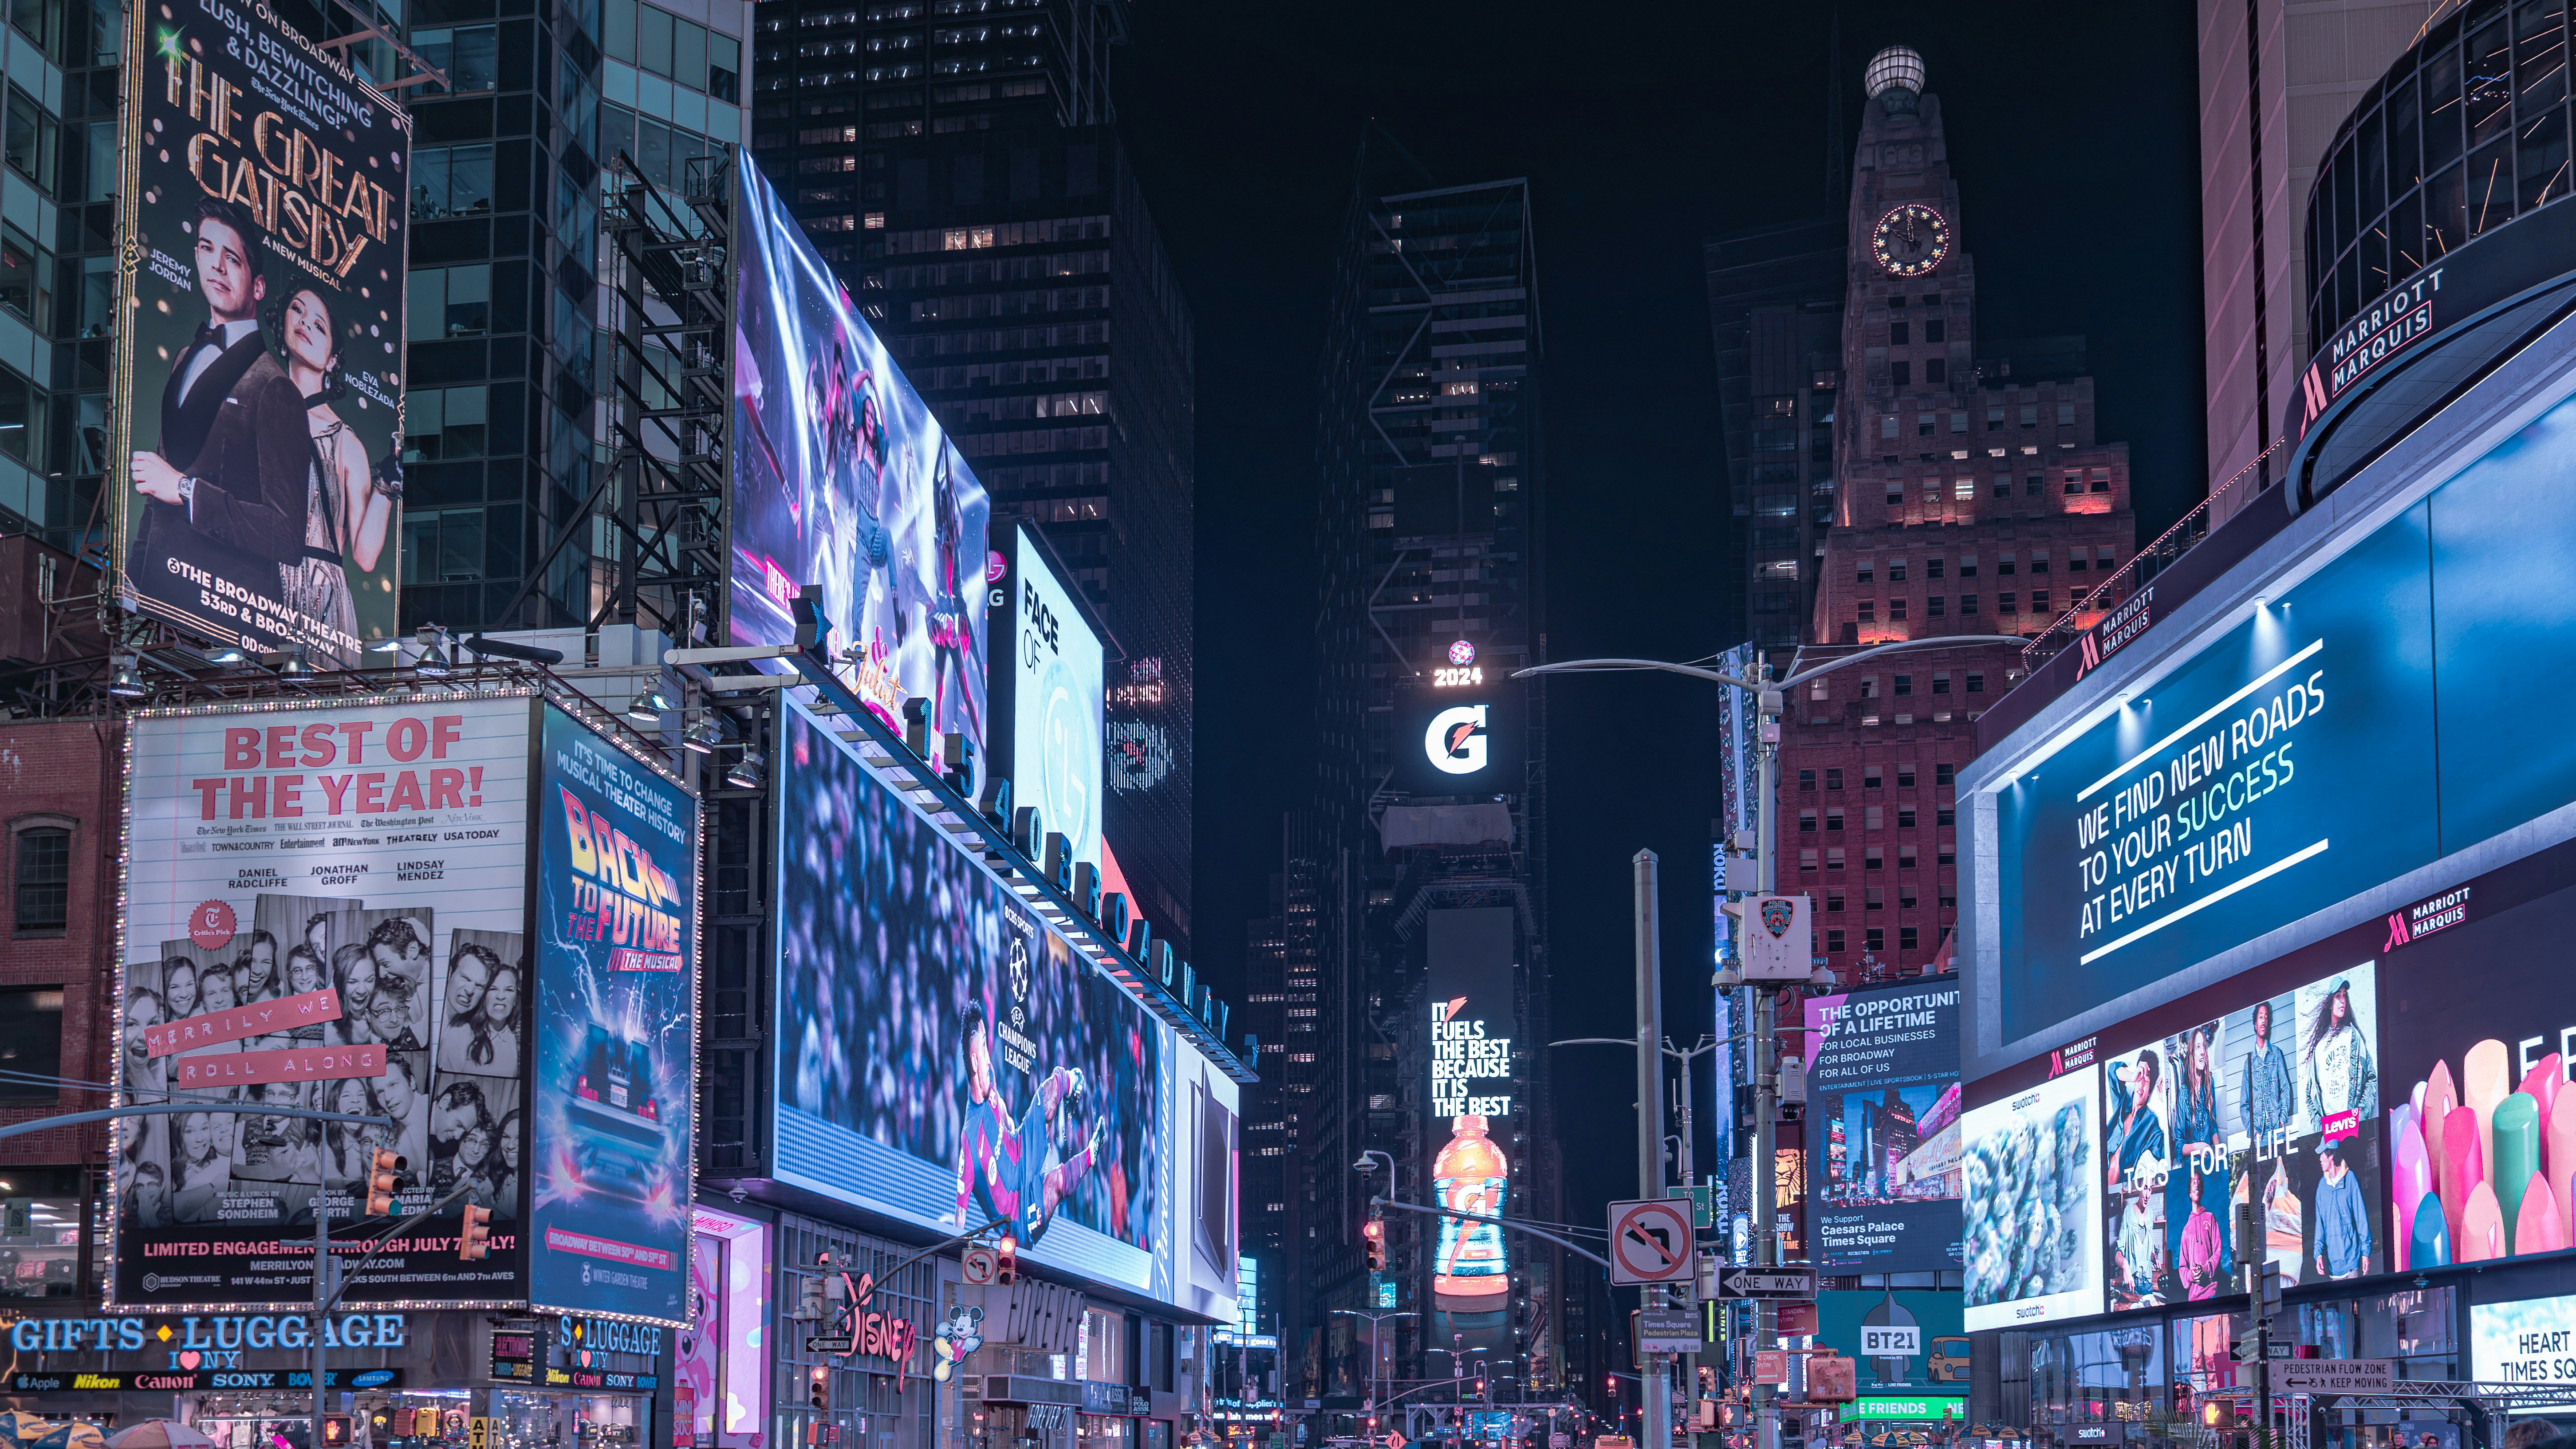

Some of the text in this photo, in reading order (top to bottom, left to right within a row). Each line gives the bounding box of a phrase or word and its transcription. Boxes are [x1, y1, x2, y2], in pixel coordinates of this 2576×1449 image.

[282, 20, 355, 84] BROADWAY
[259, 32, 371, 128] BEWITCHING
[254, 111, 395, 244] GREAT
[188, 134, 368, 277] GATSBY
[150, 248, 191, 278] JEREMY
[149, 261, 191, 292] JORDAN
[297, 256, 342, 291] MUSICAL
[2333, 268, 2444, 363] MARRIOTT
[2335, 309, 2428, 392] MARQUIS
[180, 562, 362, 654] THE BROADWAY THEATRE
[240, 608, 252, 624] &
[1025, 577, 1058, 656] FACE
[2103, 586, 2155, 636] MARRIOTT
[2103, 611, 2149, 655] MARQUIS
[1024, 629, 1041, 674] OF
[1434, 667, 1482, 686] 2024
[224, 715, 462, 771] BEST OF
[2078, 670, 2325, 849] WE FIND NEW ROADS
[193, 766, 484, 821] THE YEAR!
[595, 753, 673, 818] TIME CHANGE
[557, 750, 685, 844] MUSICAL THEATER HISTORY
[2079, 741, 2294, 891] TO YOUR SUCCESS
[212, 842, 275, 852] TOWN&COUNTRY
[387, 834, 438, 845] THEATRELY
[239, 869, 277, 878] DANIEL
[311, 864, 369, 875] JONATHAN
[397, 860, 445, 871] LINDSAY
[397, 870, 444, 881] MENDEZ
[228, 878, 288, 889] RADCLIFFE
[321, 875, 358, 885] GROFF
[2081, 817, 2252, 939] AT EVERY TURN
[2413, 887, 2470, 919] MARRIOTT
[595, 886, 681, 952] FUTURE
[2414, 907, 2464, 936] MARQUIS
[1819, 1004, 1851, 1021] THE
[147, 1009, 273, 1049] MERRILY
[1432, 1020, 1485, 1040] FUELS
[1820, 1010, 1935, 1037] OF A LIFETIME
[998, 1021, 1036, 1059] CHAMPIONS
[1432, 1039, 1510, 1059] THE BEST
[1819, 1029, 1935, 1051] FOR LOCAL BUSINESSES
[2064, 1037, 2097, 1056] MARRIOTT
[1004, 1047, 1030, 1075] LEAGUE
[1820, 1048, 1895, 1065] FOR BROADWAY
[2065, 1052, 2094, 1069] MARQUIS
[185, 1062, 255, 1081] ROLL
[1432, 1058, 1510, 1079] BECAUSE
[1820, 1063, 1890, 1079] FOR ALL OF US
[1432, 1078, 1468, 1098] IT IS
[1819, 1081, 1866, 1091] ENTERTAINMENT
[1884, 1075, 1922, 1084] SPORTSBOOK
[1432, 1096, 1511, 1117] THE BEST
[2190, 1124, 2299, 1177] FOR LIFE
[222, 1197, 274, 1208] STEPHEN
[217, 1209, 279, 1220] SONDHEIM
[693, 1216, 734, 1232] MINISO
[1834, 1214, 1863, 1225] Support
[1821, 1222, 1904, 1235] Caesars Palace
[144, 1242, 210, 1256] LIMITED
[1822, 1235, 1896, 1247] Times Square
[369, 1275, 398, 1283] SOUTH
[399, 1274, 441, 1282] BETWEEN
[1734, 1277, 1803, 1289] ONE WAY
[1782, 1308, 1805, 1317] STANDING
[1666, 1320, 1691, 1329] Square
[11, 1318, 145, 1352] GIFTS
[585, 1318, 661, 1355] LUGGAGE
[1867, 1332, 1914, 1349] BT21
[2520, 1331, 2570, 1354] HEART
[168, 1351, 179, 1370] I
[2285, 1364, 2386, 1374] PEDESTRIAN FLOW ZONE
[546, 1369, 658, 1389] Nikon Canon SONY BOWER
[2501, 1360, 2547, 1382] TIMES
[30, 1377, 59, 1390] Apple
[73, 1374, 120, 1390] Nikon
[134, 1374, 194, 1389] Canon
[212, 1373, 272, 1386] SONY
[2331, 1378, 2387, 1388] KEEP MOVING
[1027, 1404, 1070, 1429] FOREVER 21
[1868, 1403, 1926, 1414] FRIENDS
[2078, 1427, 2102, 1439] swatch
